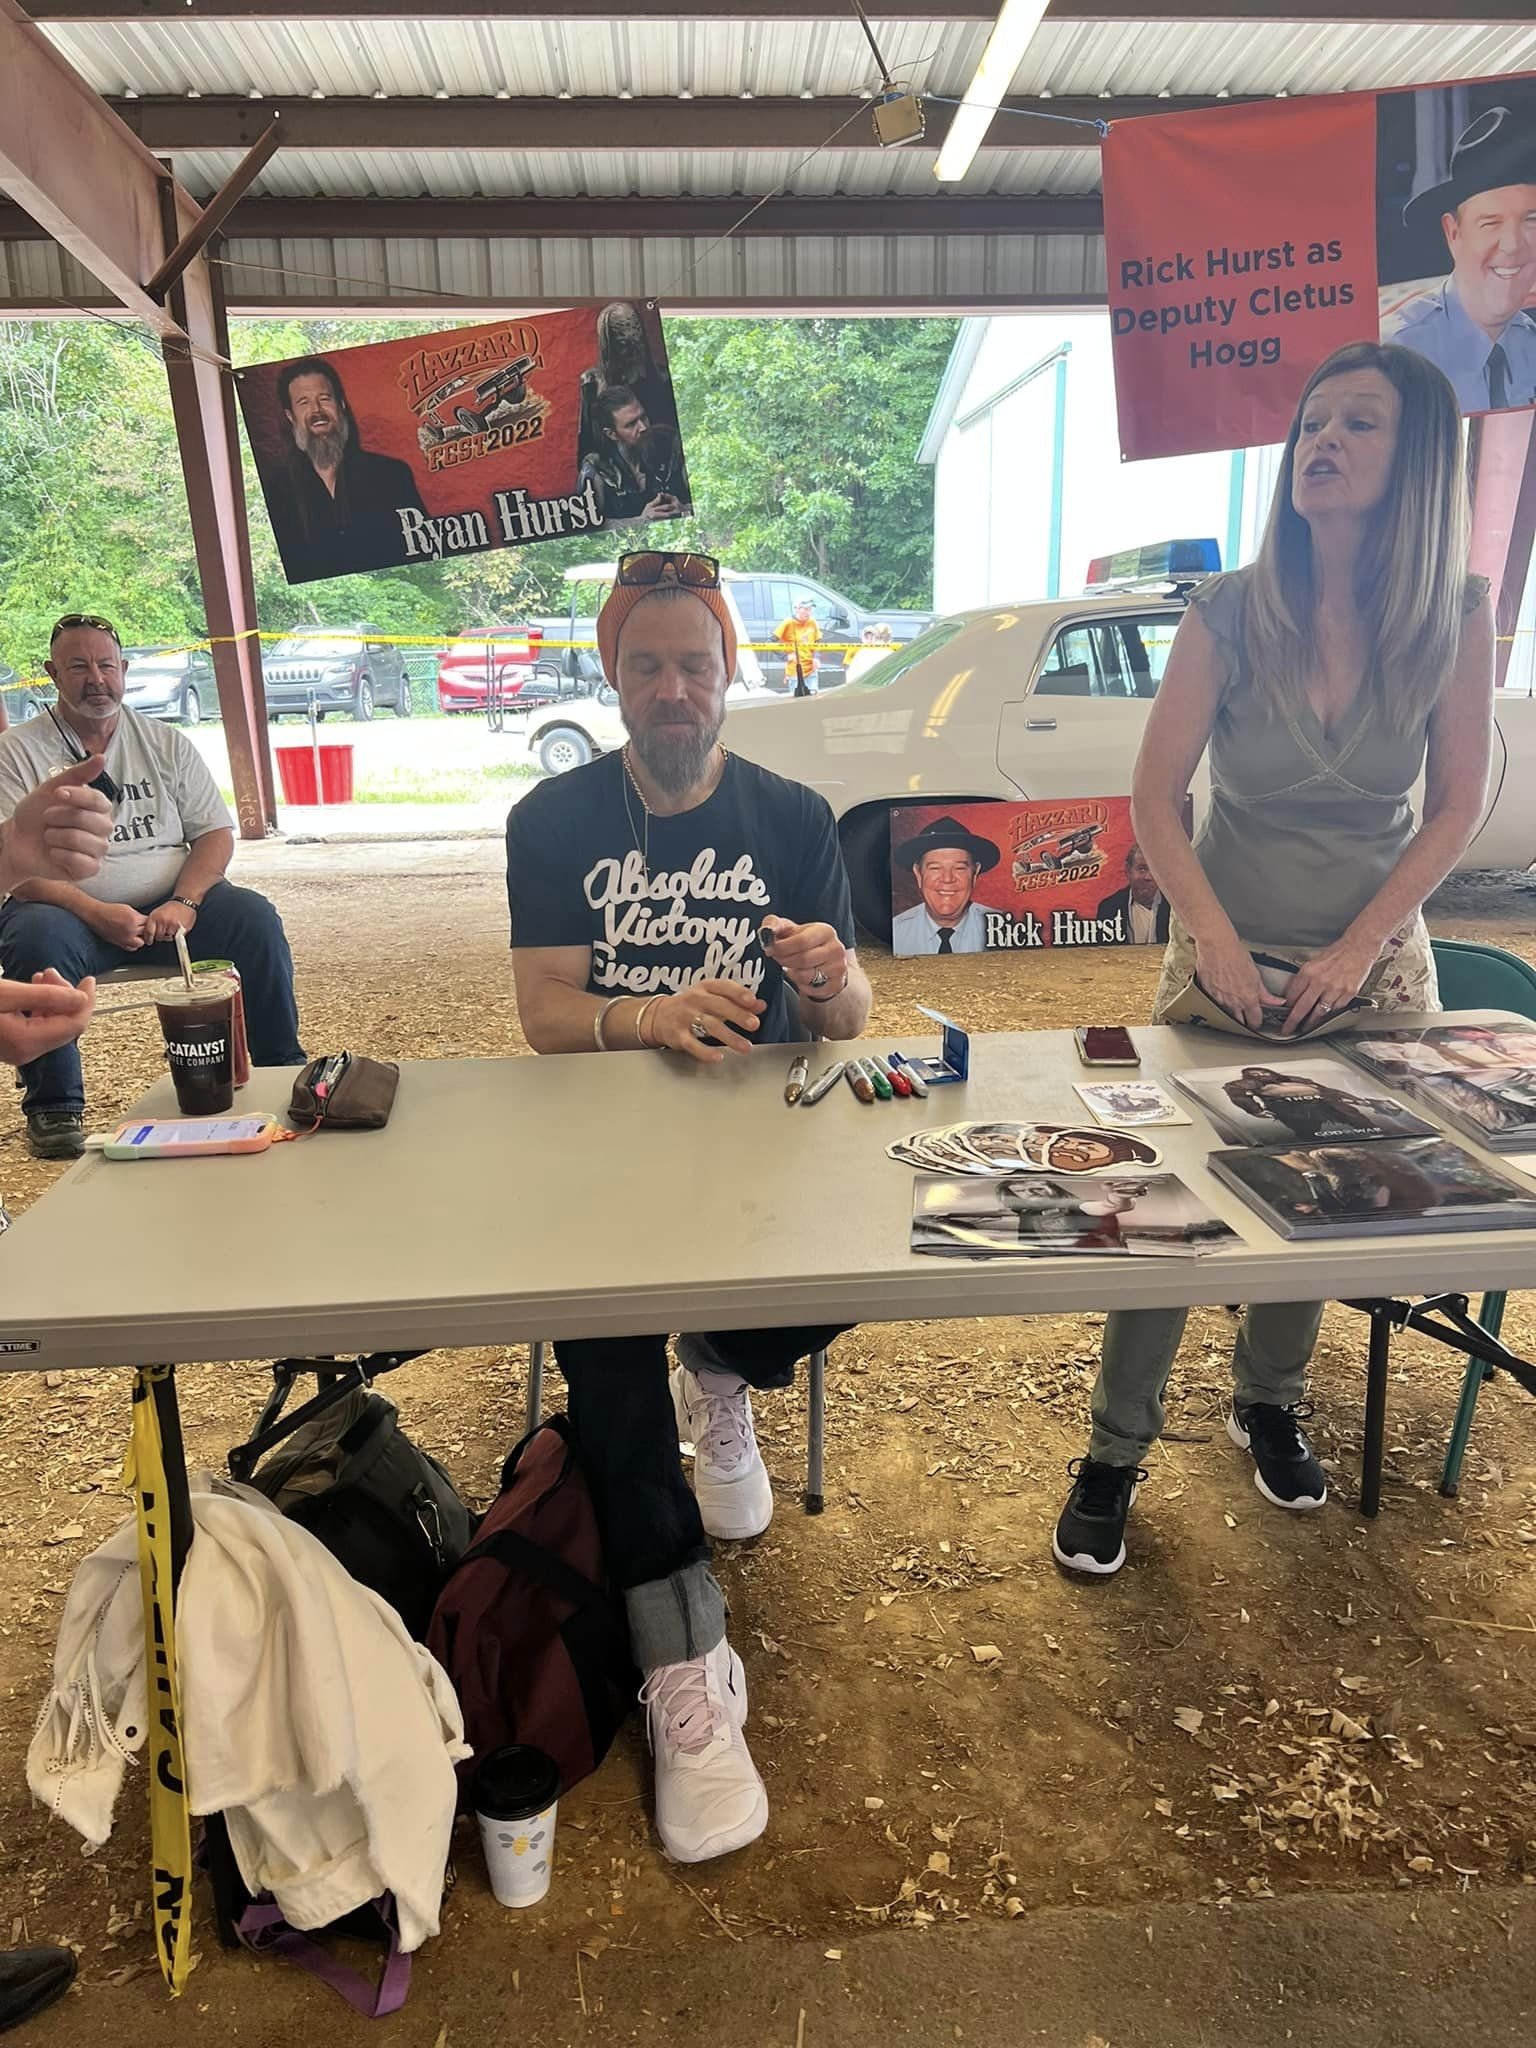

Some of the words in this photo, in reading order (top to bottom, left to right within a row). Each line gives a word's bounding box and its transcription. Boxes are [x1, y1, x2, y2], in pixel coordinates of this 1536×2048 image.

[1120, 252, 1195, 290] Rick
[1207, 241, 1295, 277] Hurst
[1306, 240, 1344, 265] as
[1112, 296, 1237, 336] Deputy
[1249, 282, 1355, 317] Cletus
[404, 325, 540, 396] HAZZARD
[1189, 336, 1282, 369] Hogg
[396, 507, 490, 560] Ryan
[495, 478, 604, 542] Hurst
[1011, 802, 1108, 838] HAZZARD
[583, 848, 770, 909] Absolute
[604, 898, 756, 964] Victory
[986, 913, 1043, 948] Rick
[1052, 909, 1126, 946] Hurst
[169, 1039, 225, 1057] CATALYST
[186, 1054, 225, 1067] COMPANY
